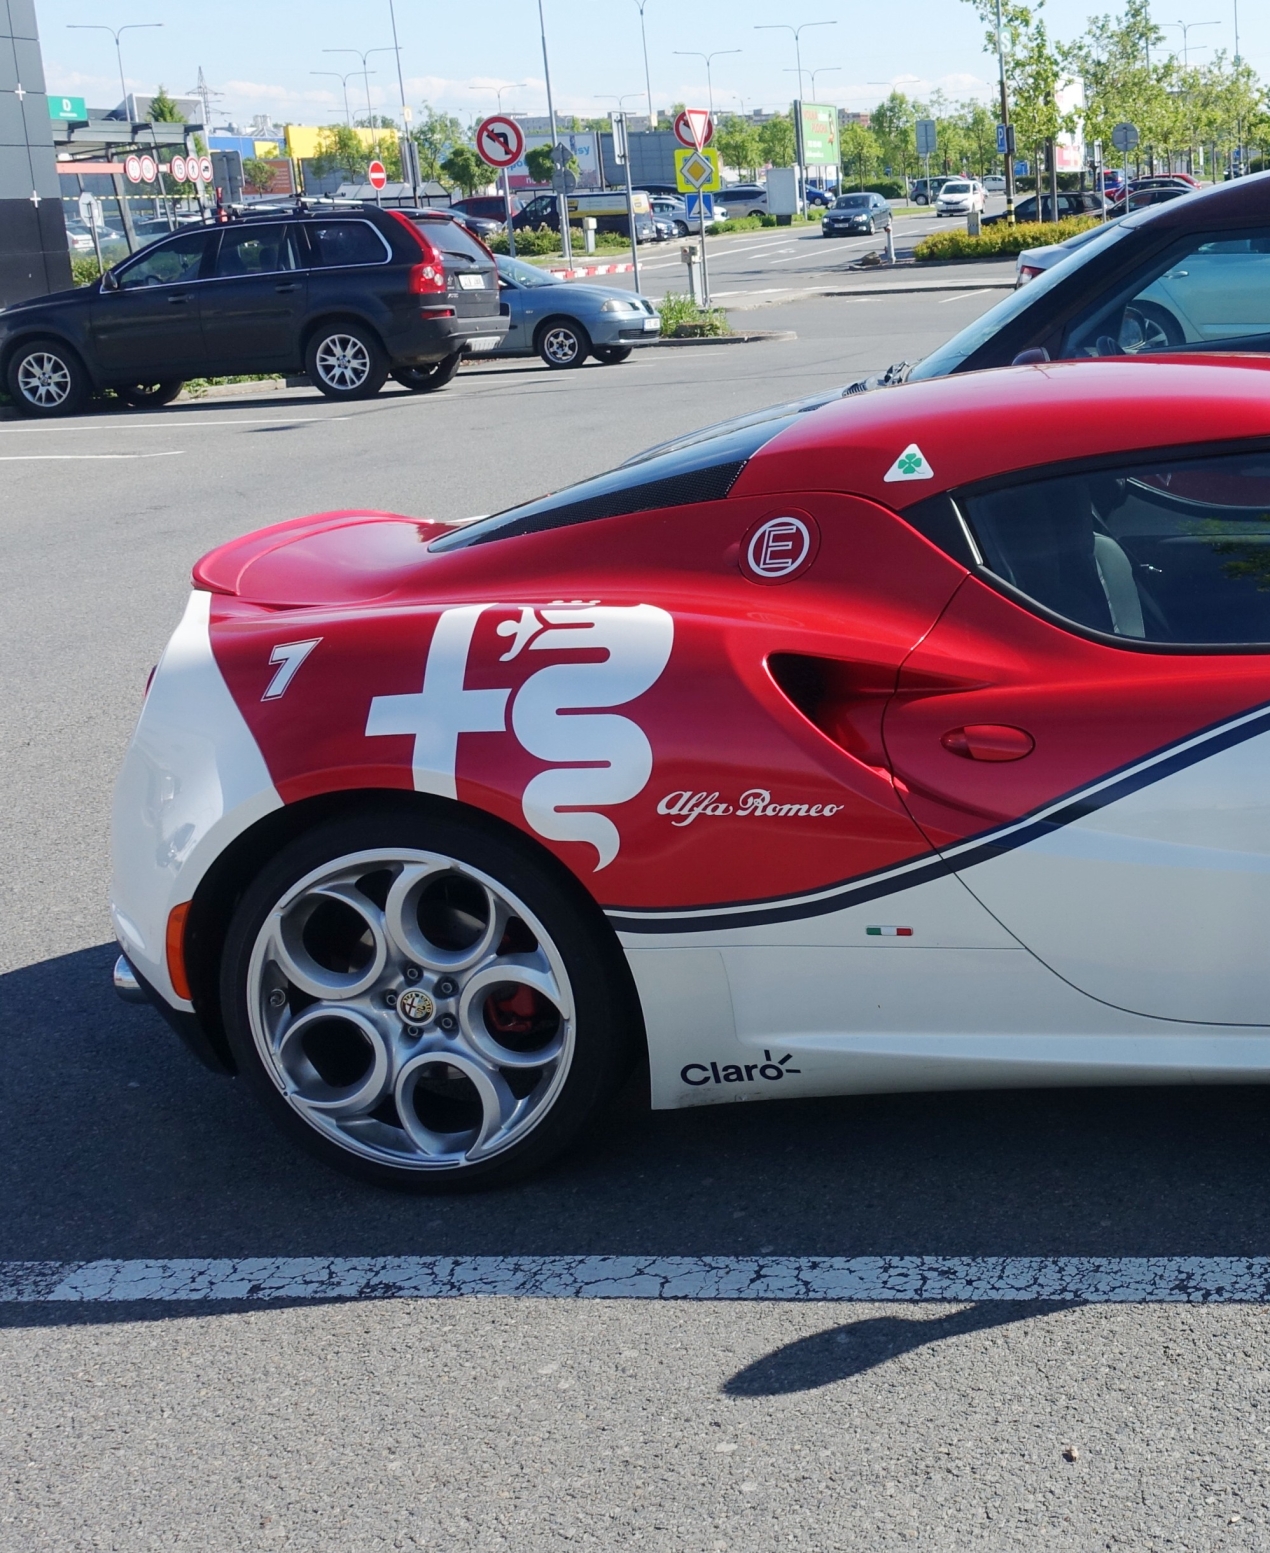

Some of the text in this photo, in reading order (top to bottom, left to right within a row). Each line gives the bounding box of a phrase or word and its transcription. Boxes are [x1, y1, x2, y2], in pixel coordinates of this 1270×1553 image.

[1000, 31, 1011, 52] S
[61, 98, 72, 111] D
[176, 164, 183, 174] 15
[656, 788, 845, 827] Alfa Romeo
[680, 1058, 787, 1086] Claro
